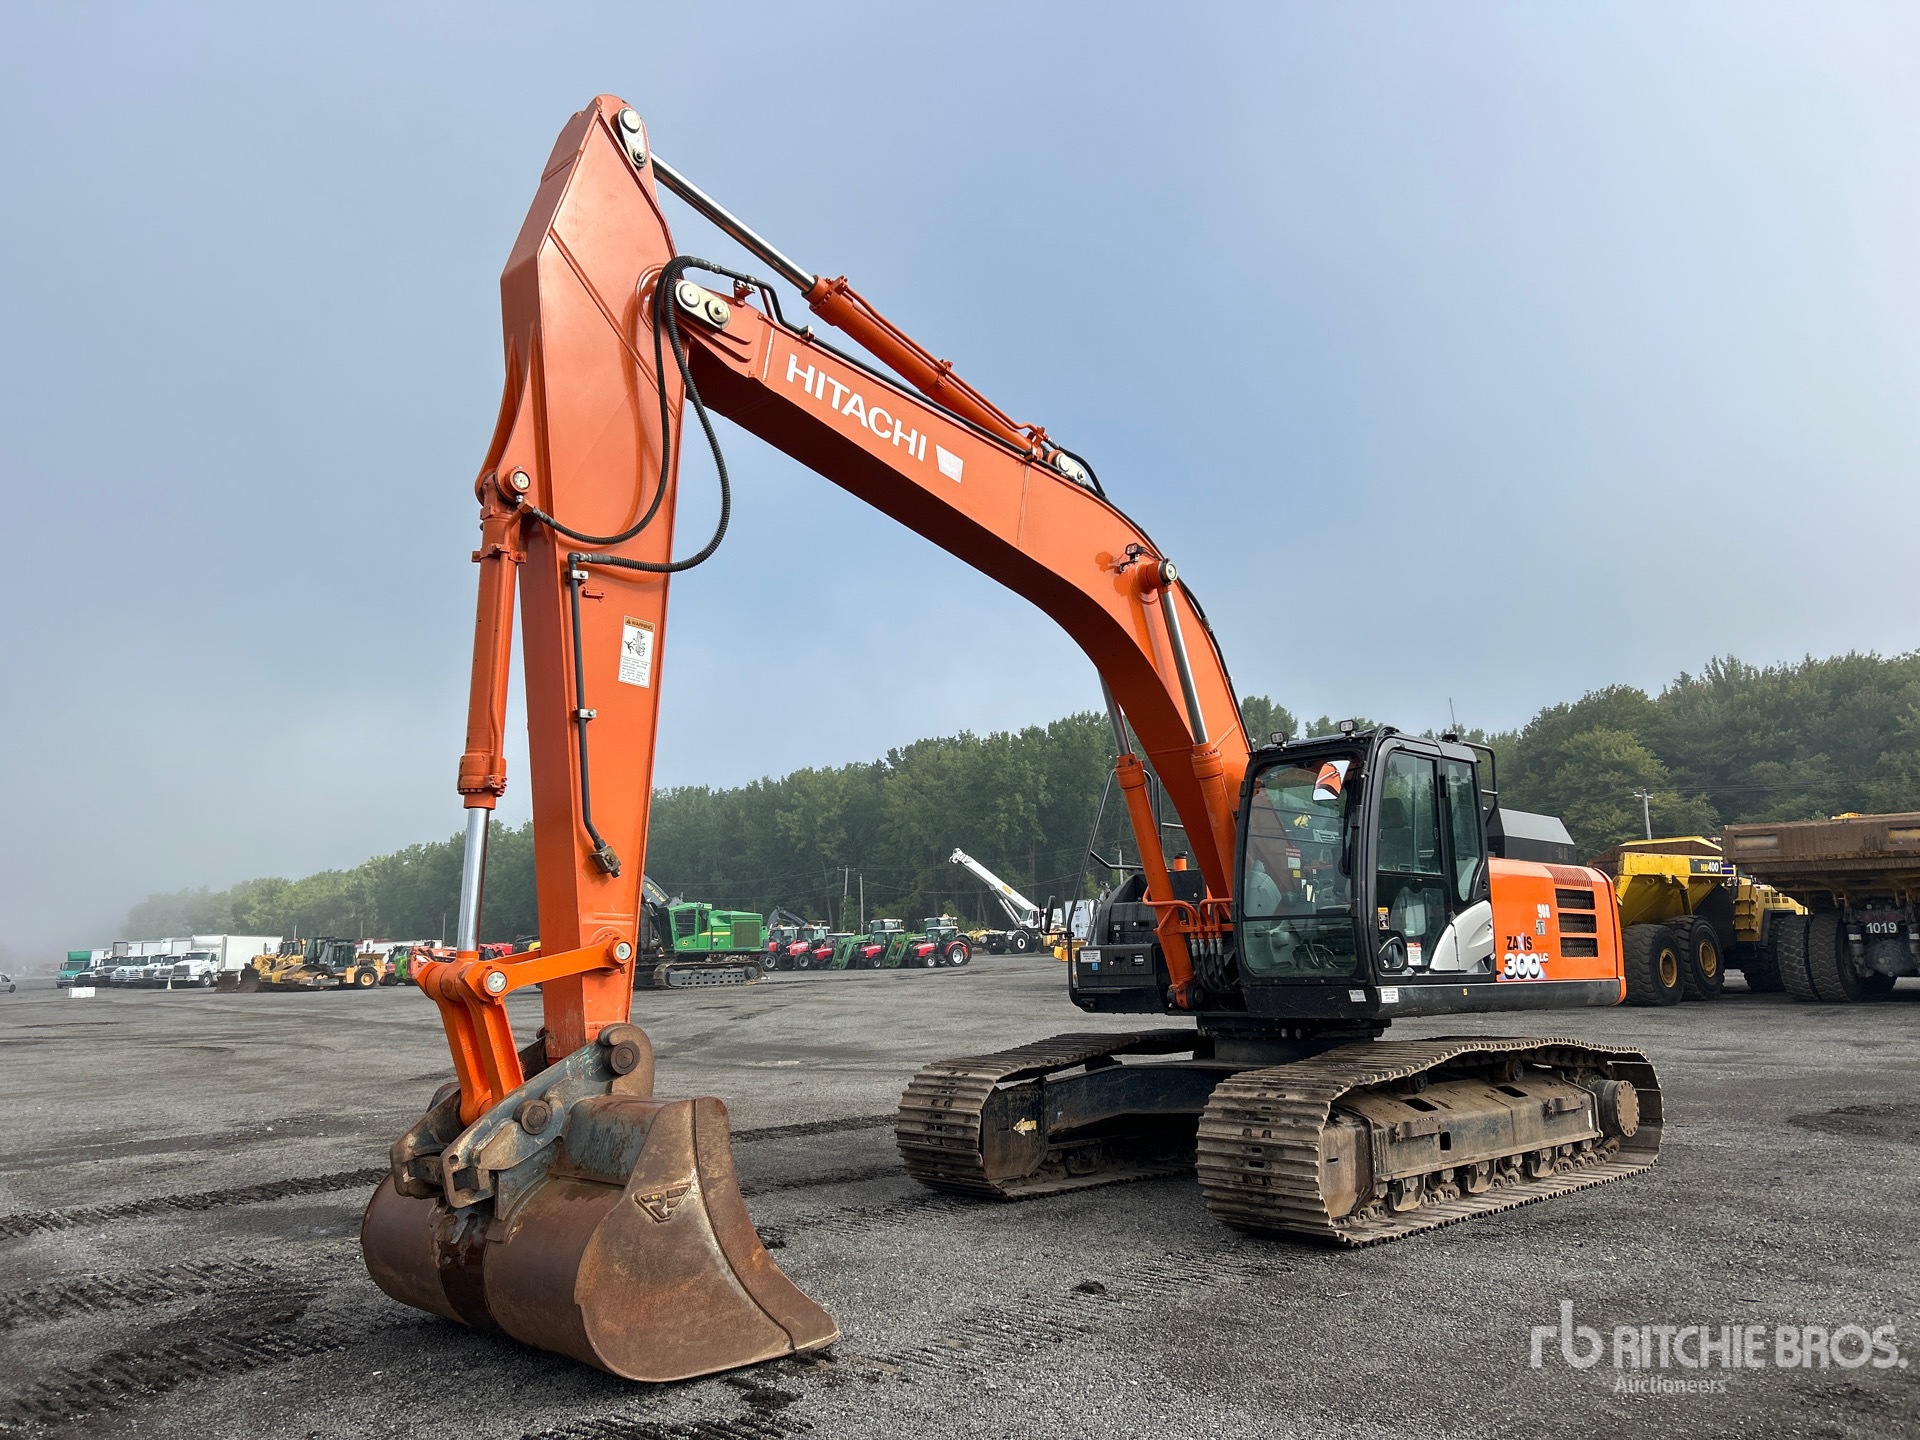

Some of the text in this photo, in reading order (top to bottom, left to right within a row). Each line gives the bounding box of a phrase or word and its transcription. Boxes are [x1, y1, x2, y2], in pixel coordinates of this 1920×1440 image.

[785, 353, 927, 462] HITACHI
[631, 620, 653, 631] WARNING
[1866, 921, 1897, 934] 1019
